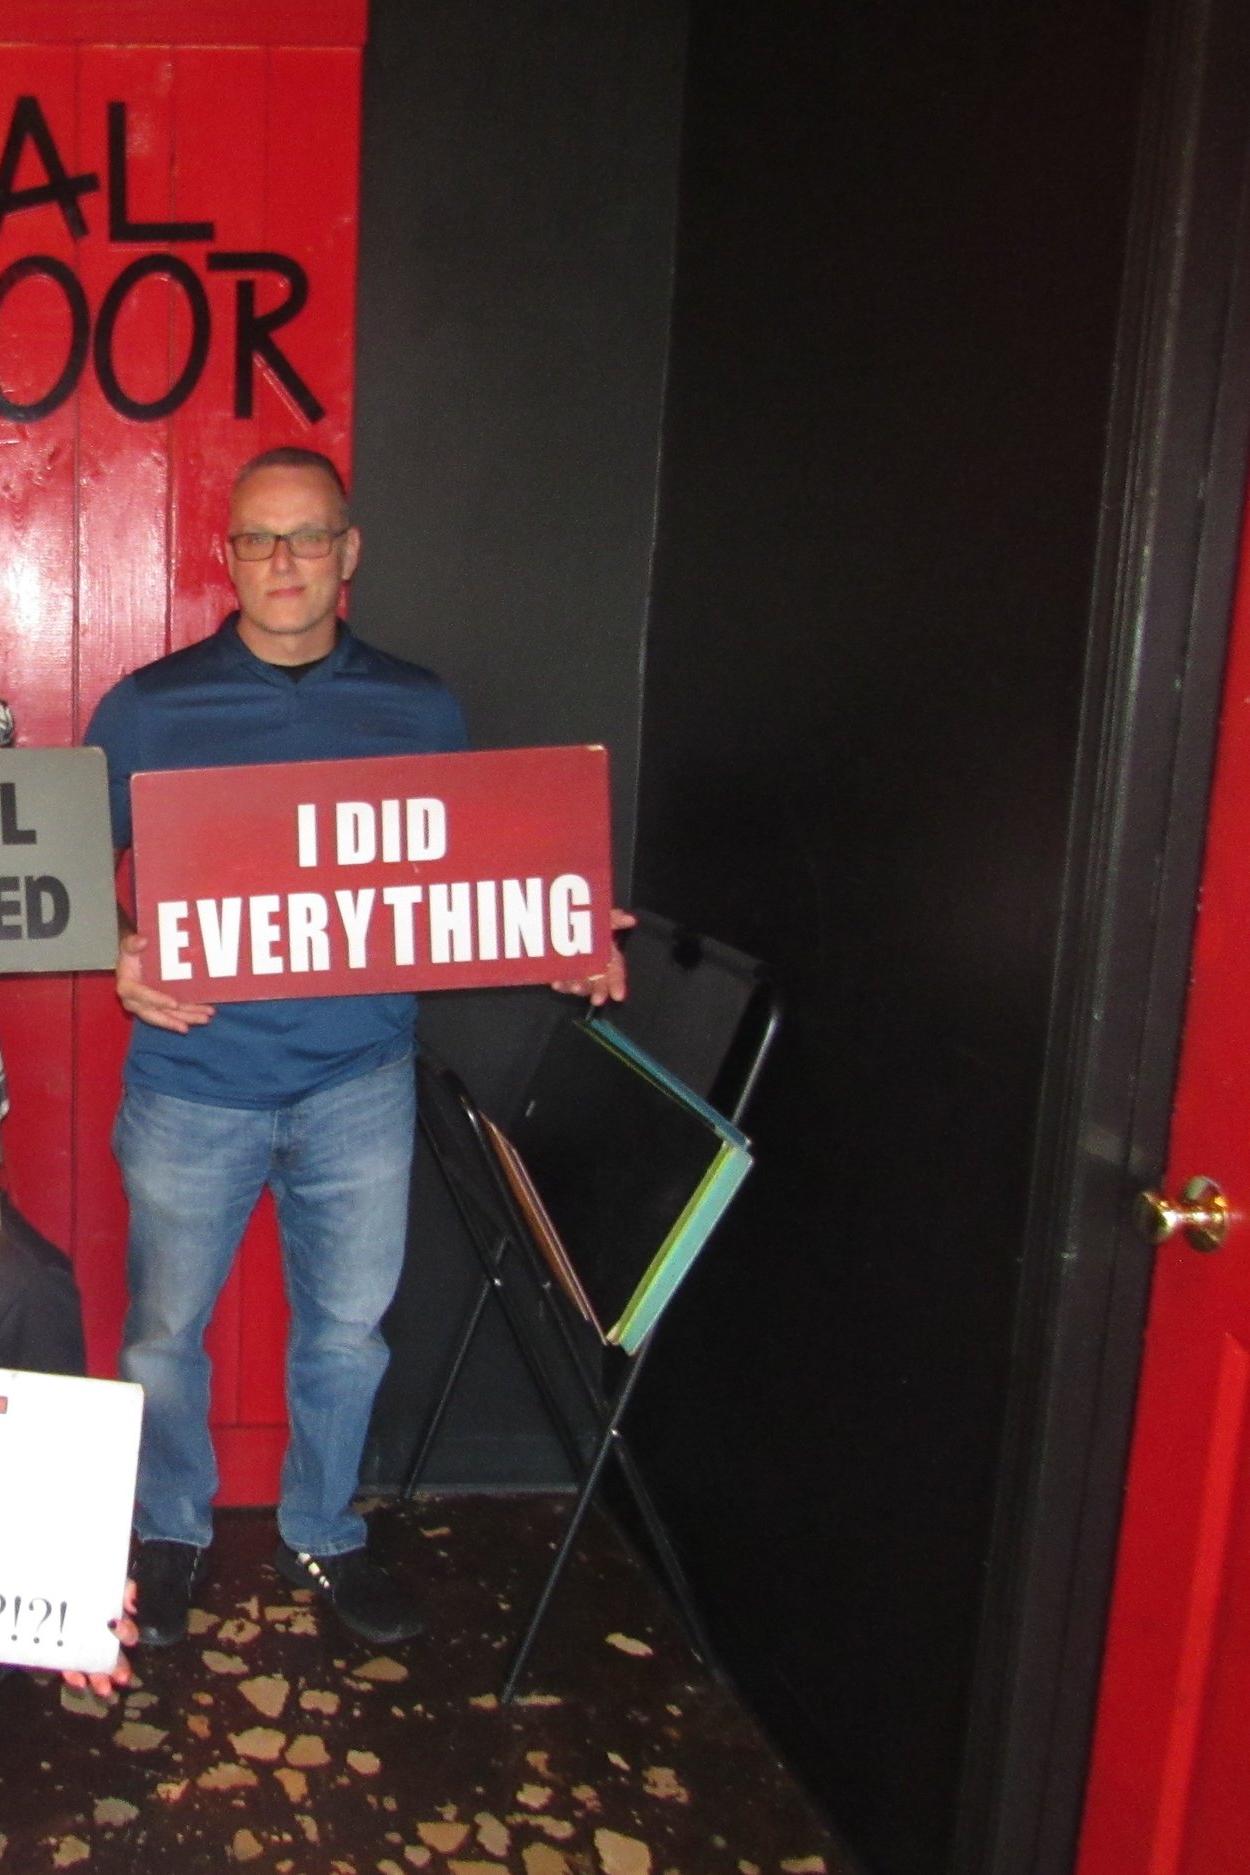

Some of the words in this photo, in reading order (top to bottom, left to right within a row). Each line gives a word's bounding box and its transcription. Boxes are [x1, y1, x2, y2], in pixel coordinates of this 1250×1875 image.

[298, 804, 317, 867] I
[336, 798, 447, 865] DID
[158, 874, 592, 981] EVERYTHING
